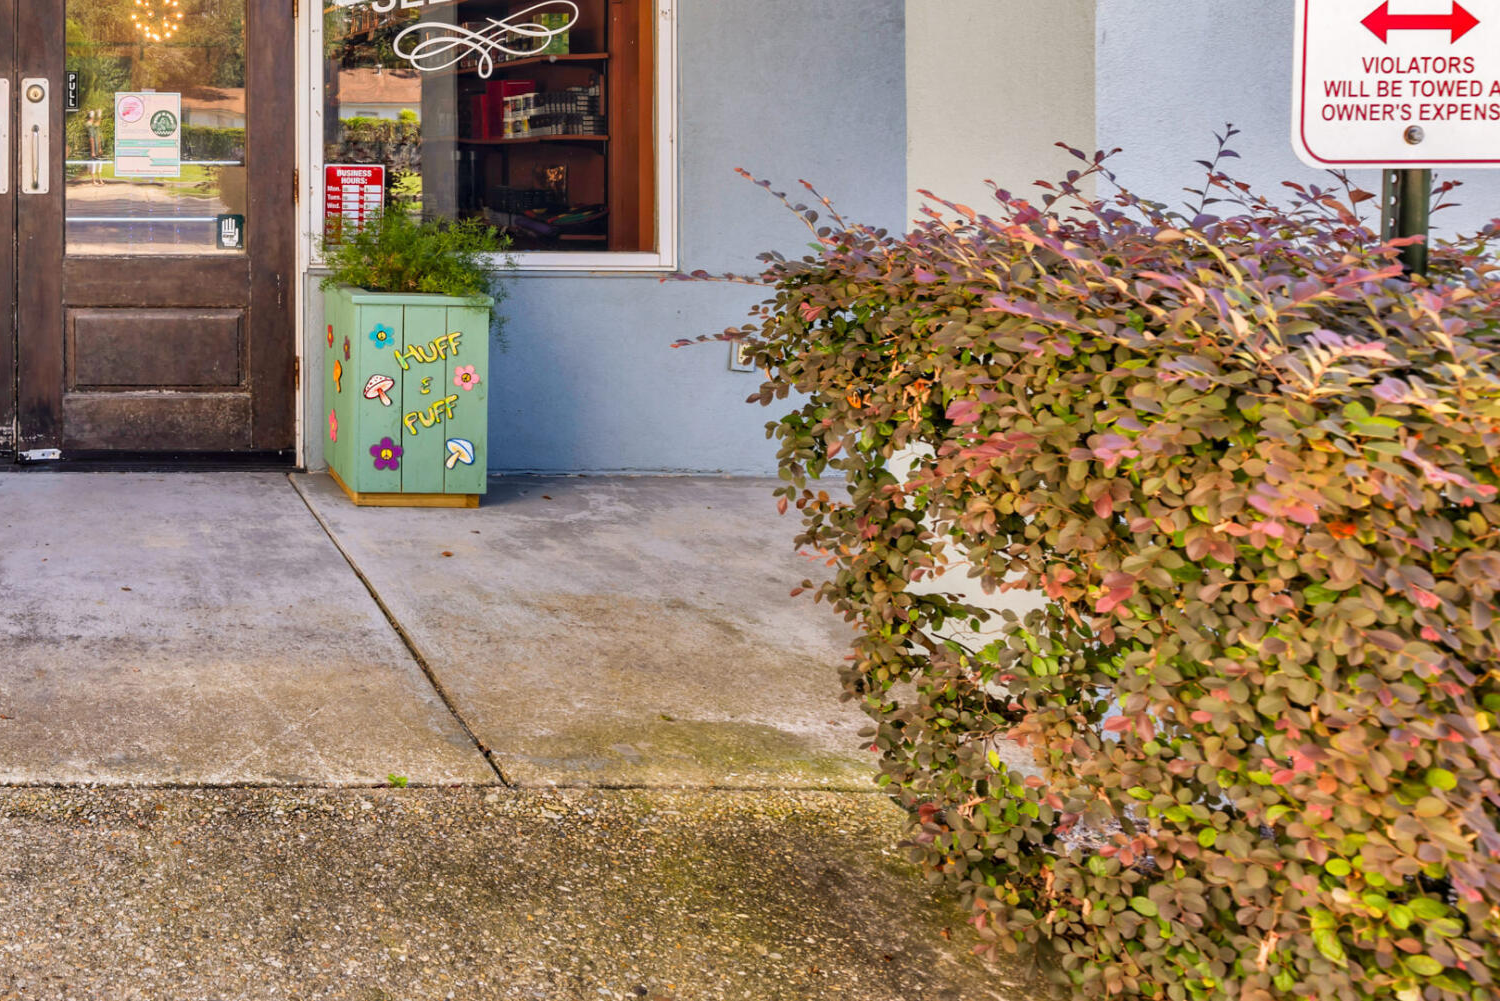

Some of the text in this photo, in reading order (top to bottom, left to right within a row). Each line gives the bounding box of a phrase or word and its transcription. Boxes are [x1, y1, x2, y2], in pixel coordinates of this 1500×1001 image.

[1361, 56, 1476, 74] VIOLATORS
[68, 73, 76, 107] PULL
[1323, 80, 1500, 98] WILL BE TOWED A
[1321, 103, 1500, 121] OWNER'S EXPENS
[336, 169, 373, 177] BUSINESS
[393, 331, 462, 371] HUFF
[403, 393, 460, 436] PUFF
